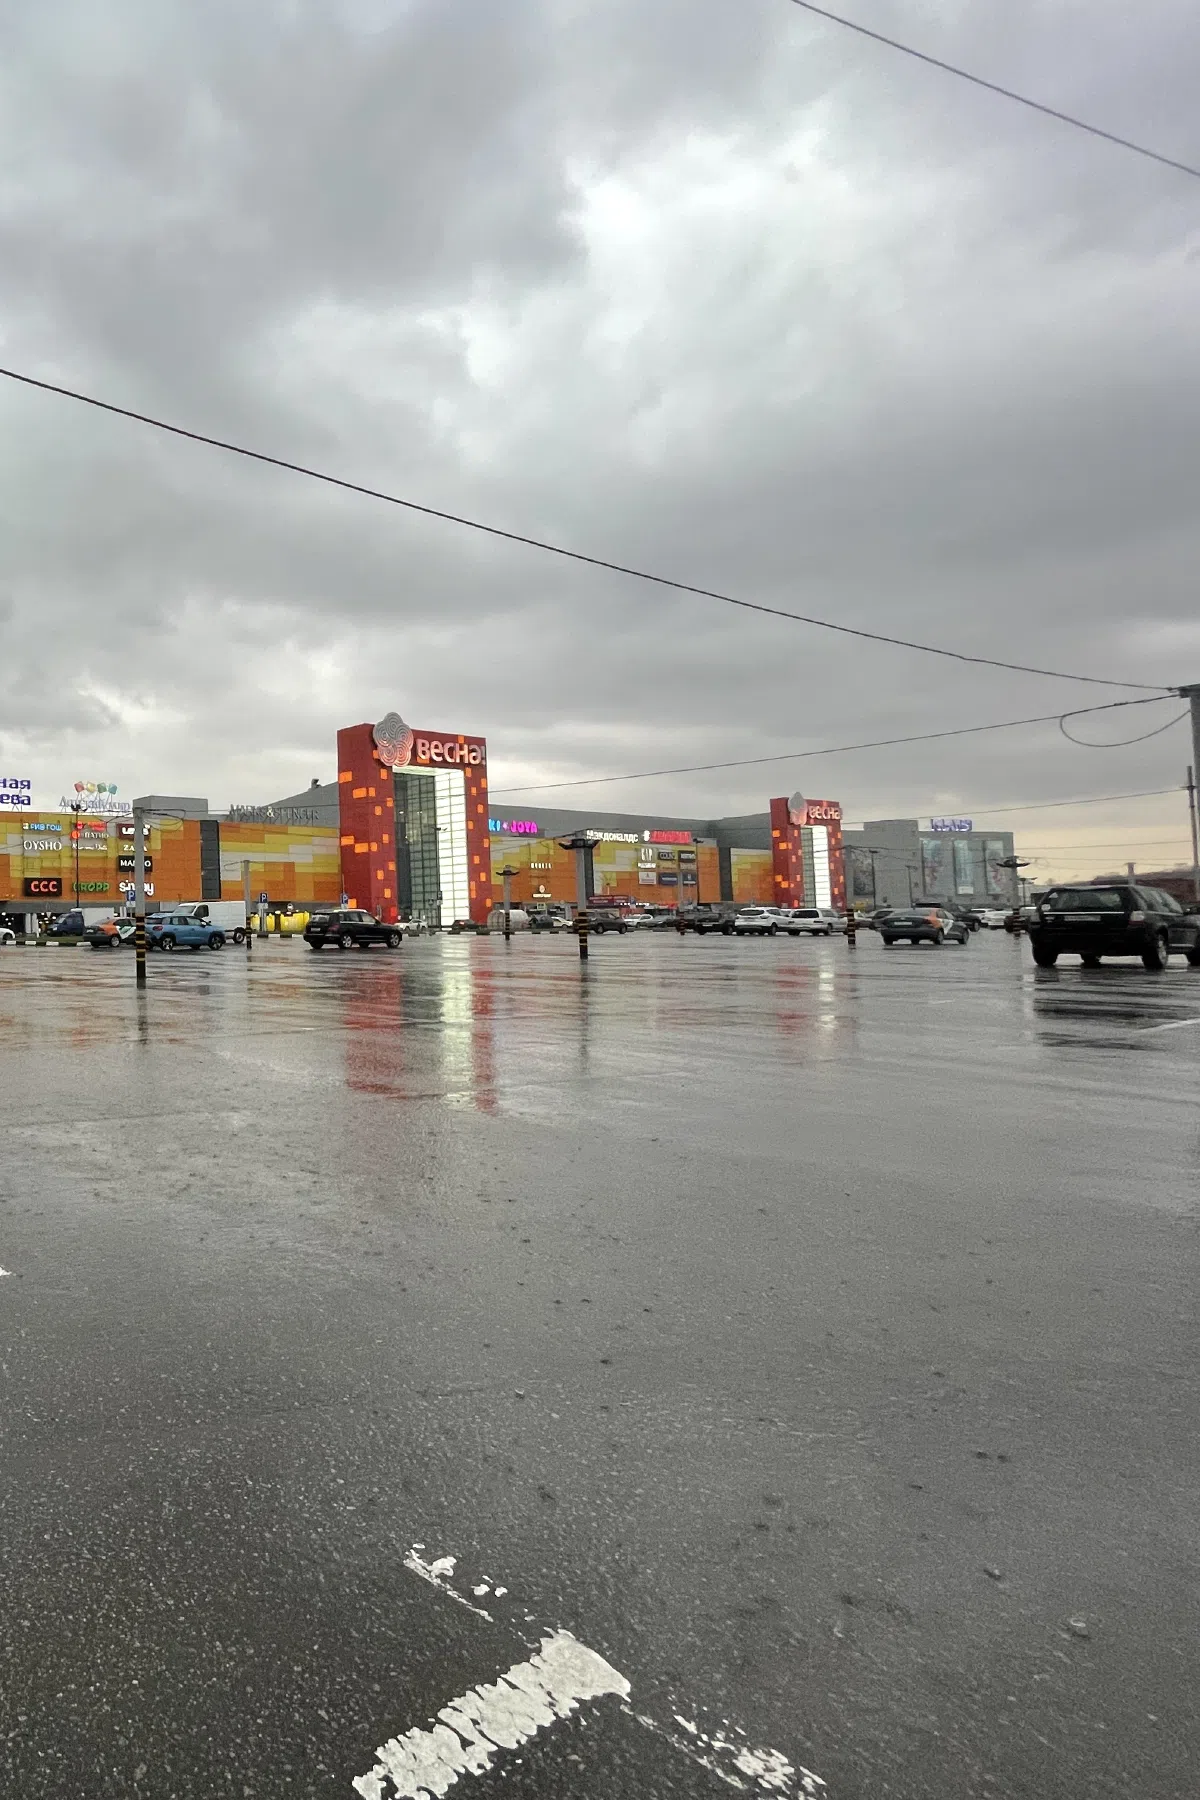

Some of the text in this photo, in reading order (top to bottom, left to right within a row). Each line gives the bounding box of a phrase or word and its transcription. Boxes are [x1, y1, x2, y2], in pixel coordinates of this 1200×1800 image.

[23, 840, 62, 851] OYSHO
[123, 844, 148, 852] ZAA
[30, 880, 58, 892] CCC
[73, 882, 110, 892] CROPP
[119, 880, 155, 896] siny
